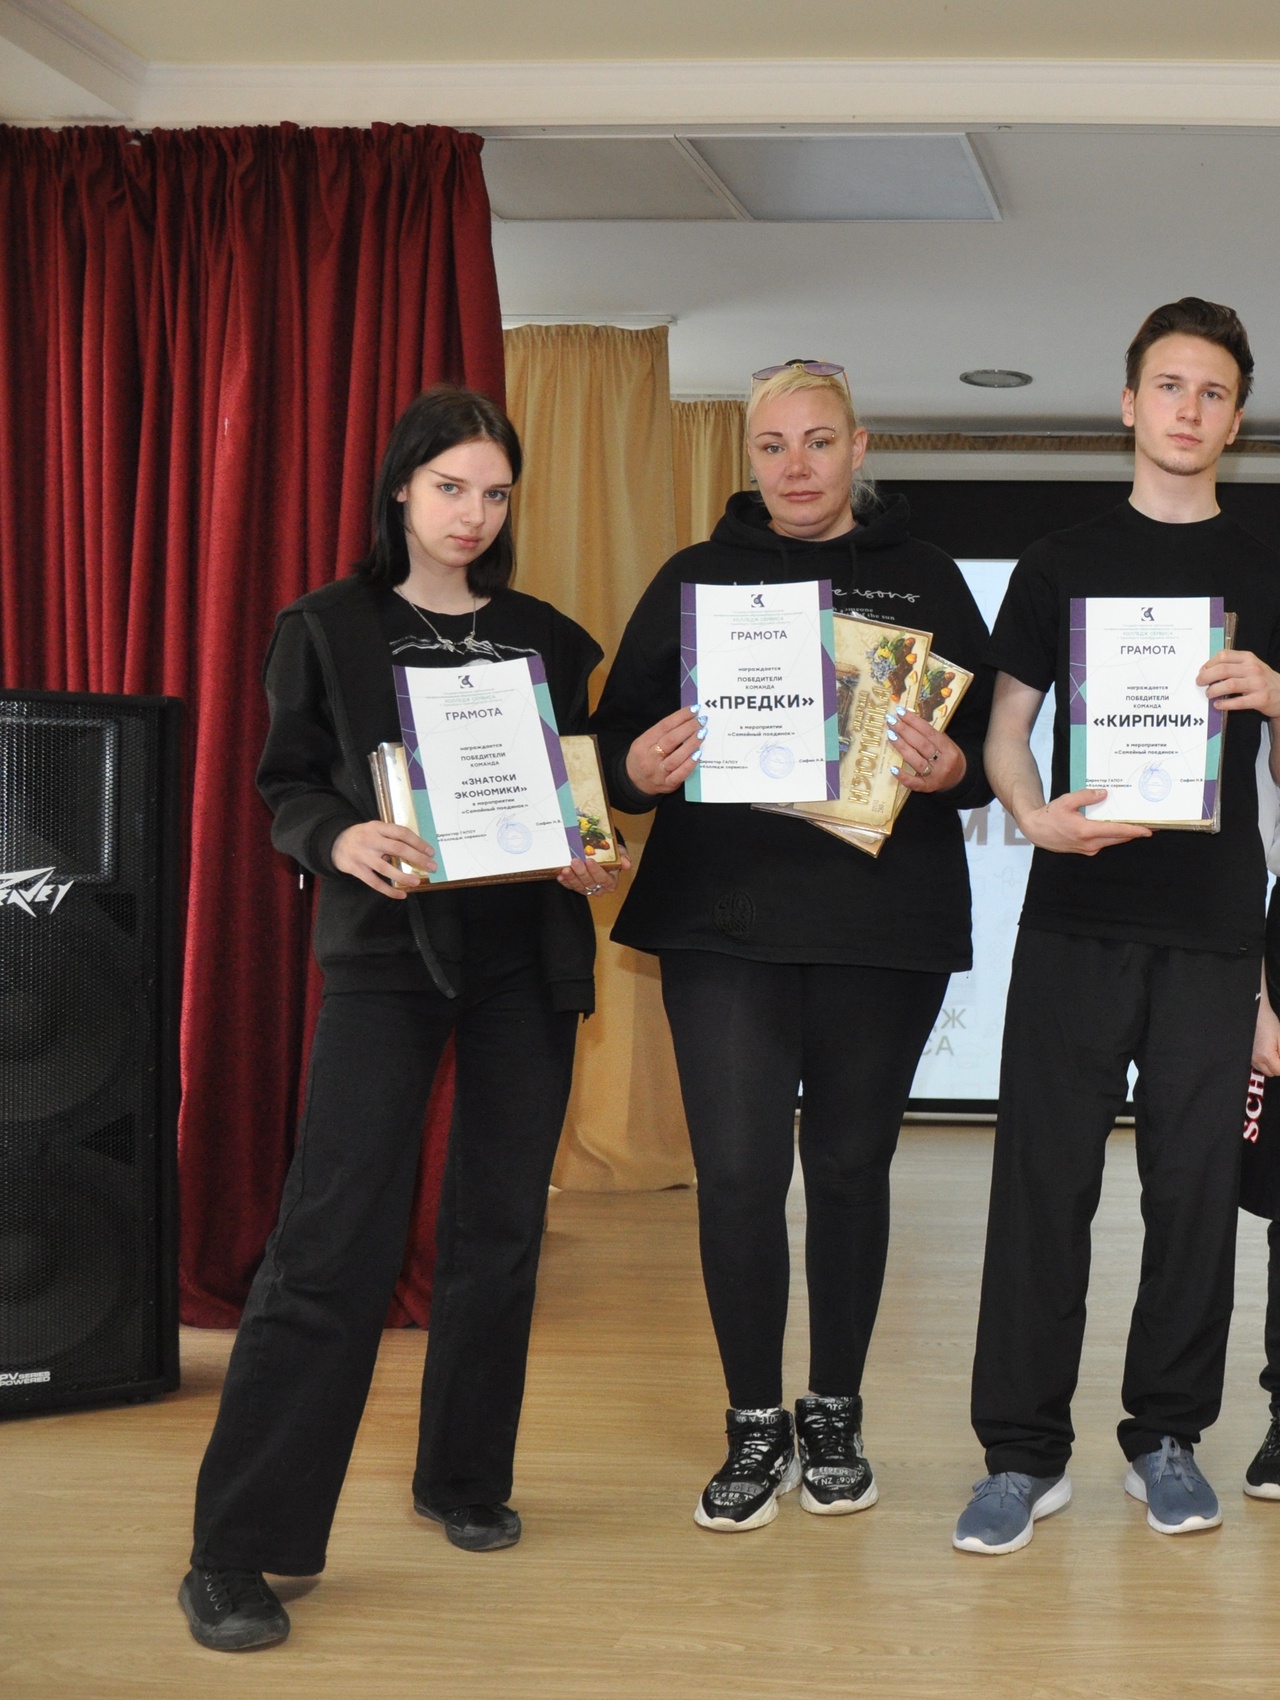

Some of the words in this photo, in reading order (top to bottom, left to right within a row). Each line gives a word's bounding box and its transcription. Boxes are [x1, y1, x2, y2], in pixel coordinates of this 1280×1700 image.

[731, 630, 788, 641] ГРАМОТА
[1120, 645, 1176, 655] ГРАМОТА
[705, 694, 814, 711] «ПРЕДКИ»
[445, 707, 503, 721] ГРАМОТА
[1093, 714, 1205, 728] «КИРПИЧИ»
[459, 743, 502, 751] награждается
[849, 686, 891, 805] ИЗЮМИНКА
[461, 752, 506, 761] ПОБЕДИТЕЛИ
[461, 774, 517, 786] «ЗНАТОКИ
[454, 786, 528, 799] ЭКОНОМИКИ»
[477, 798, 515, 807] мероприятии
[1242, 1068, 1266, 1144] SCH
